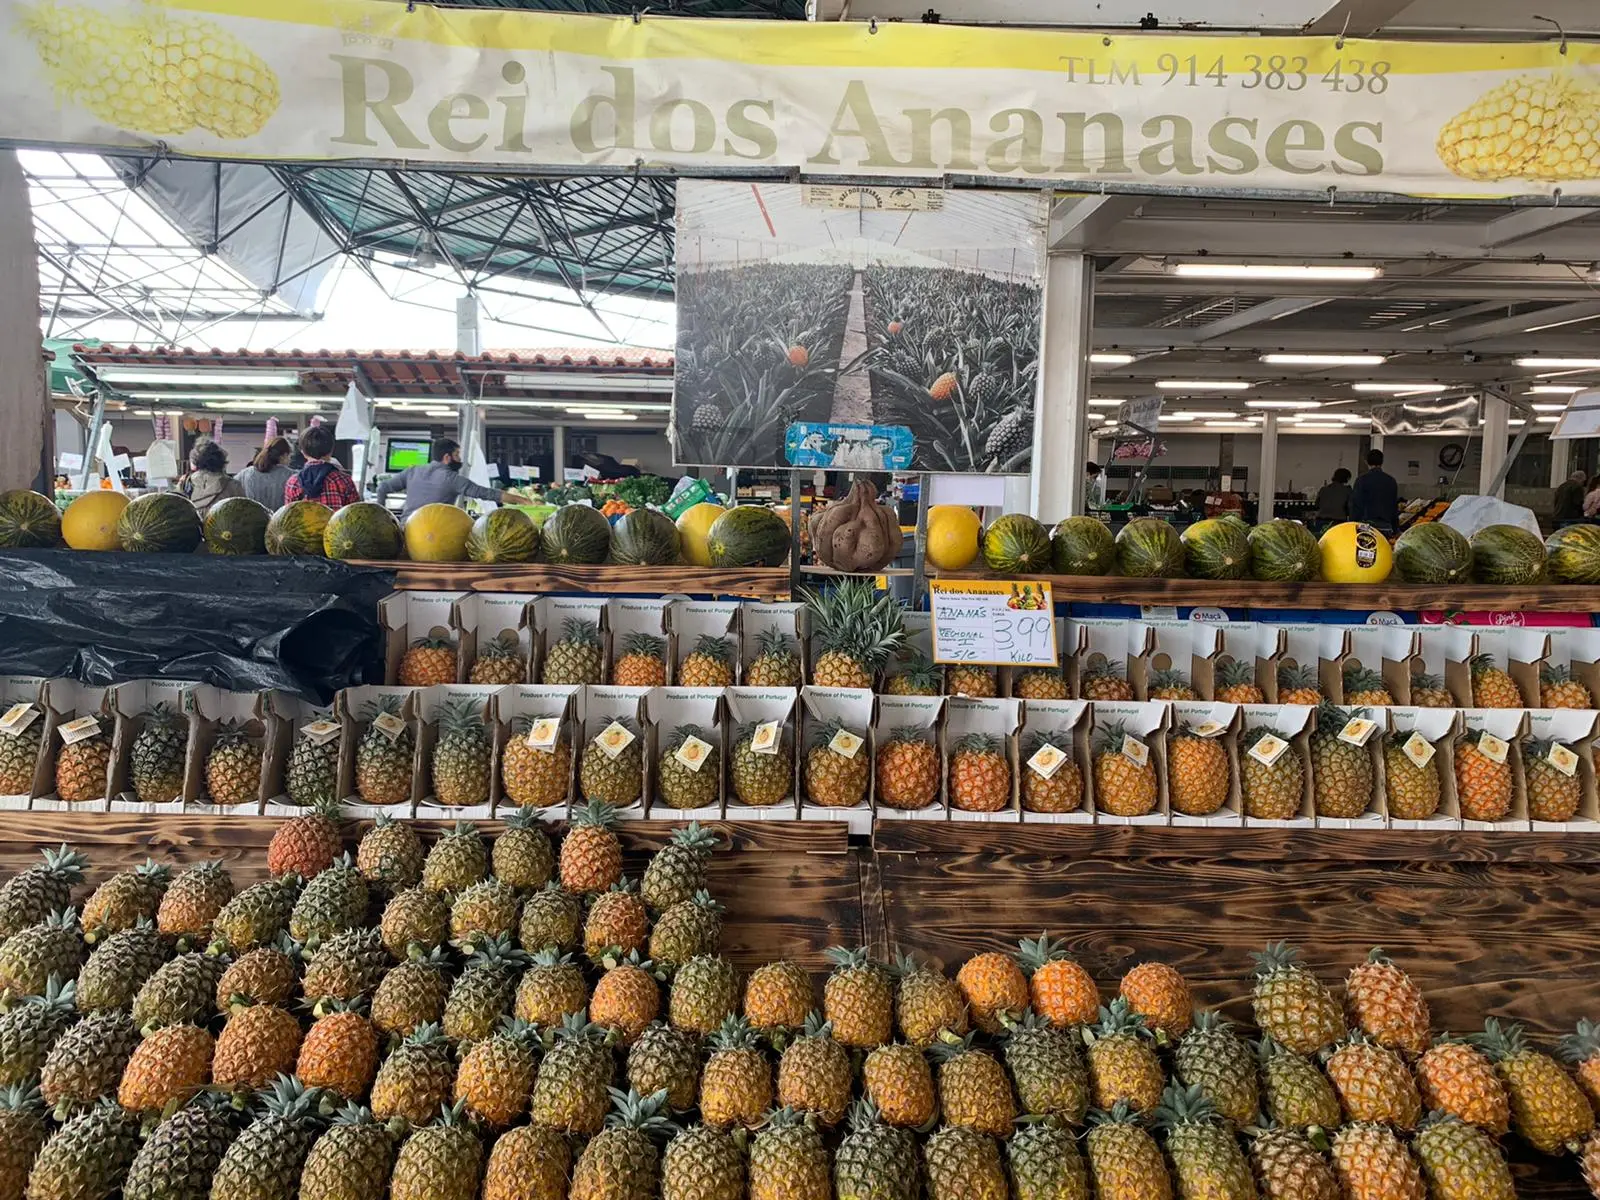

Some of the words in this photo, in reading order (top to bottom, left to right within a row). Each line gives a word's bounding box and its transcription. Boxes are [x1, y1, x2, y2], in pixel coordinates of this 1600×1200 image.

[1058, 55, 1143, 86] TLM
[1157, 53, 1228, 87] 914
[1241, 54, 1308, 91] 383
[1321, 58, 1392, 94] 438
[330, 53, 532, 153] Rei
[569, 65, 778, 160] dos
[806, 80, 1385, 176] Ananases
[933, 586, 948, 595] Rei
[949, 587, 964, 595] dos
[967, 588, 1005, 596] Ananases
